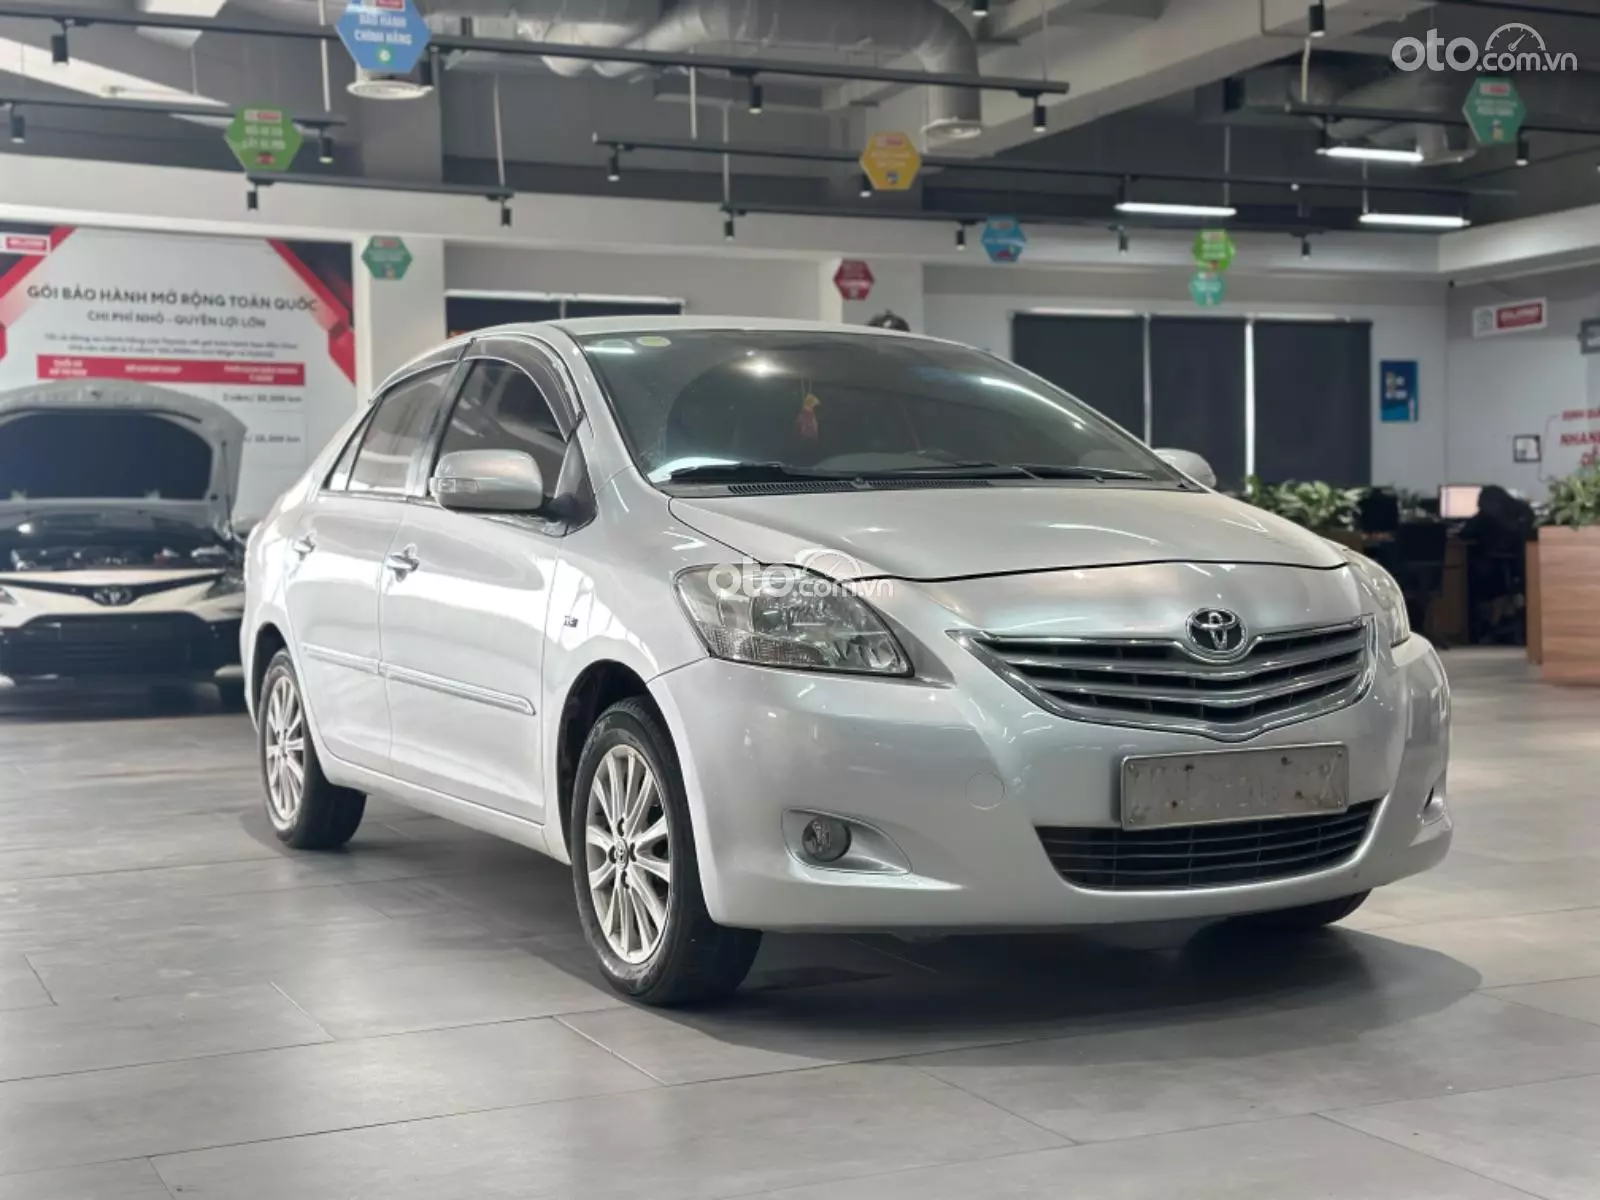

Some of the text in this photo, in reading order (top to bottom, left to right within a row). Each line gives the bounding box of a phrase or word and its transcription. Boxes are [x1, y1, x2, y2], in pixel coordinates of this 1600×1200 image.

[62, 283, 96, 300] BẢO
[100, 285, 147, 303] HÀNH
[181, 289, 226, 308] RỘNG
[229, 293, 271, 309] TOÀN
